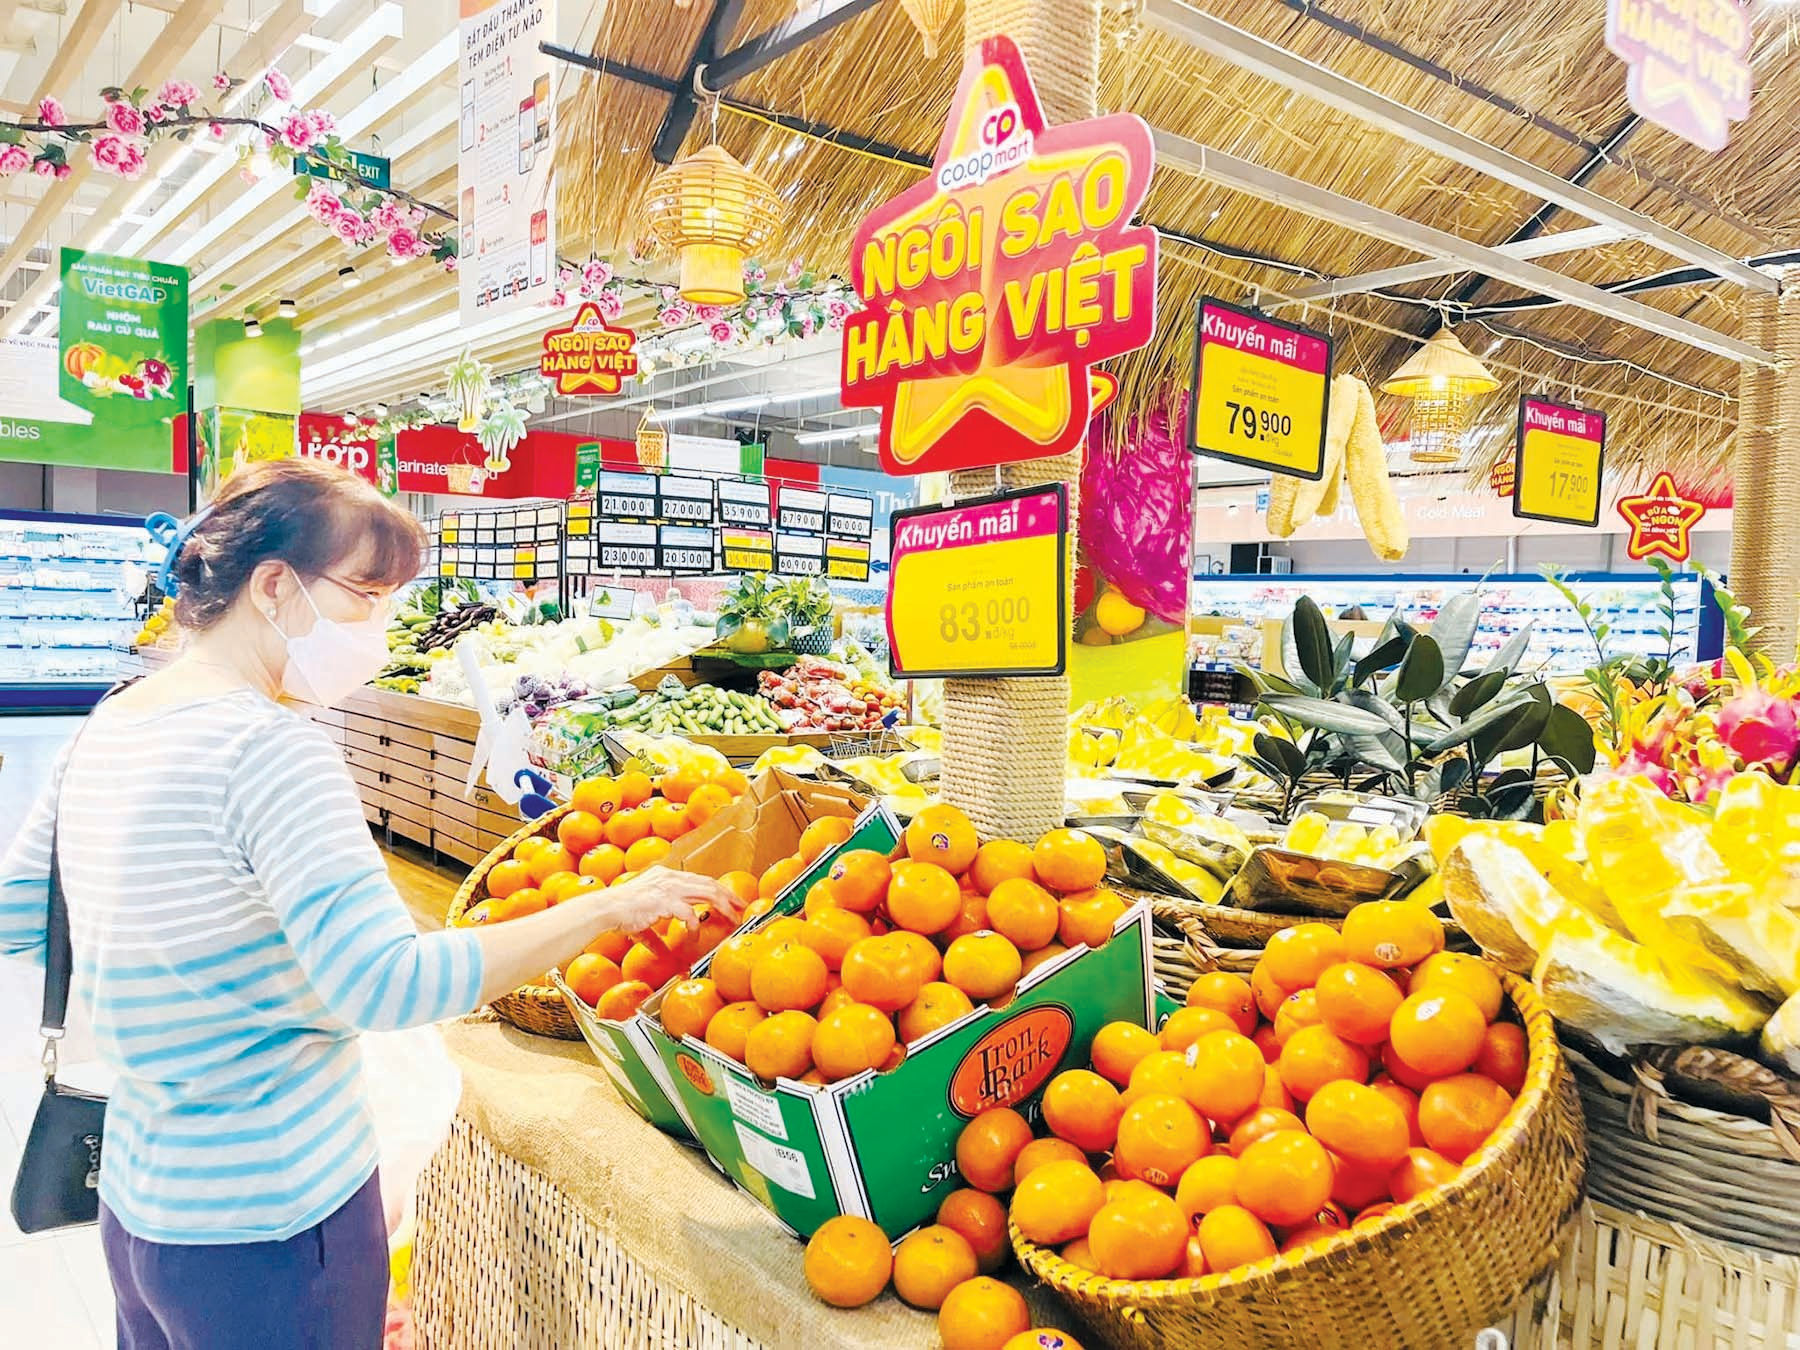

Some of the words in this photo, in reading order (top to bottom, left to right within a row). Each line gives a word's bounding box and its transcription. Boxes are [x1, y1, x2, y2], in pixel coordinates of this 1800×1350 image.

[358, 163, 381, 180] EXIT
[862, 204, 984, 299] NGÔI
[1000, 155, 1127, 257] SAO
[83, 277, 166, 303] VietGAP
[846, 293, 987, 385] HÀNG
[1004, 243, 1148, 348] VIỆT
[547, 334, 590, 352] NGÔI
[595, 335, 631, 351] SAO
[1201, 312, 1266, 350] Khuyến
[1269, 336, 1298, 361] mãi
[542, 352, 592, 371] HÀNG
[596, 351, 636, 373] VIỆT
[1525, 406, 1565, 431] Khuyến
[898, 513, 973, 549] Khuyến
[978, 506, 1019, 537] mãi
[1651, 515, 1684, 526] NGON
[978, 1026, 1034, 1100] Iron
[992, 1026, 1052, 1102] Bark
